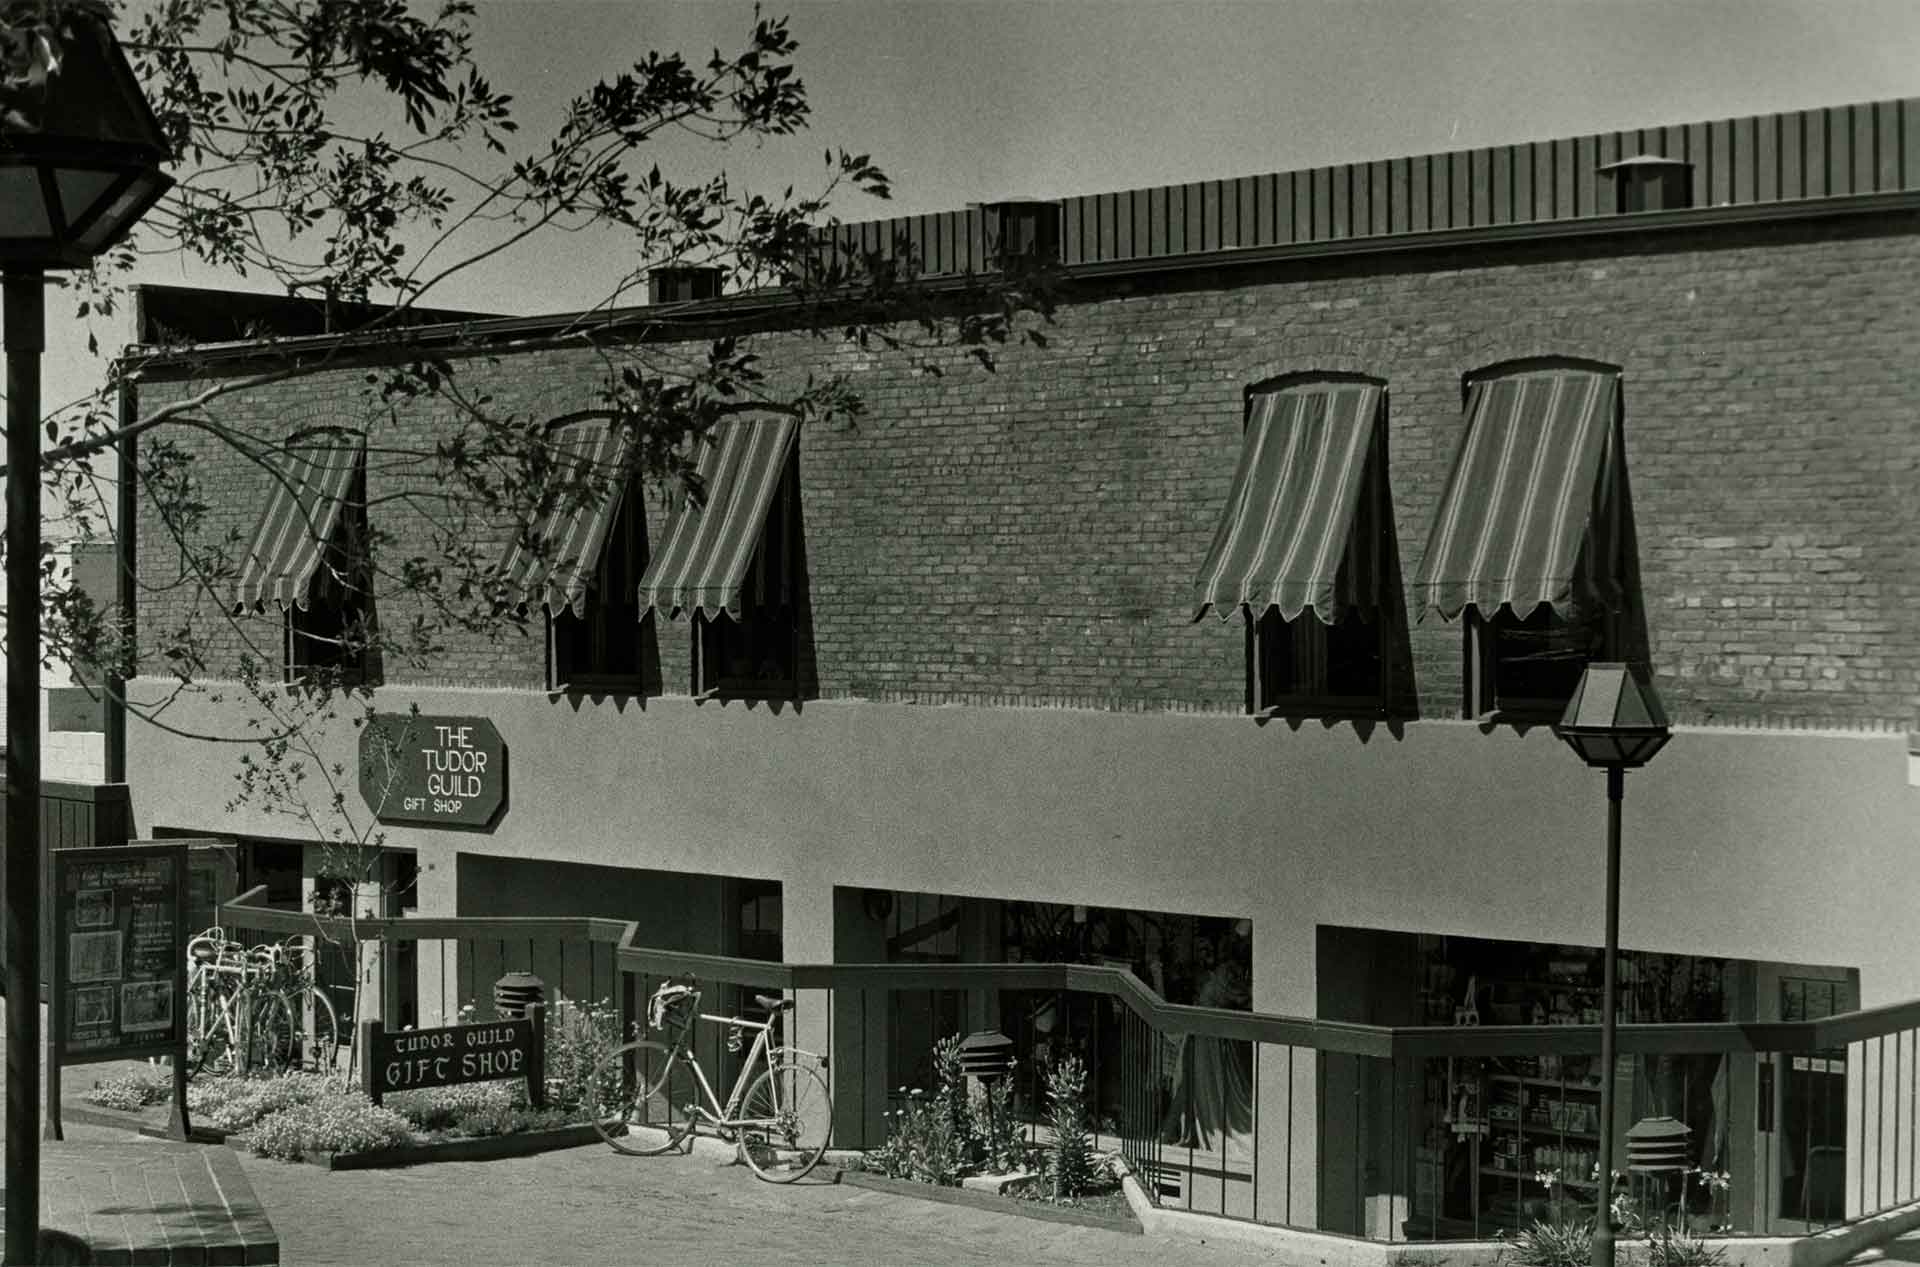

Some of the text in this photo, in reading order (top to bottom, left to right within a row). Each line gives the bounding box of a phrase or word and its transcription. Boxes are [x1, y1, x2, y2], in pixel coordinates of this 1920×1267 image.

[434, 726, 474, 748] THE
[421, 749, 488, 773] TUDOR
[427, 773, 482, 798] GUILD
[403, 797, 463, 813] GIFT SHOP
[394, 1028, 515, 1053] TUDOR GUILD
[386, 1048, 523, 1086] GIFT SHOP
